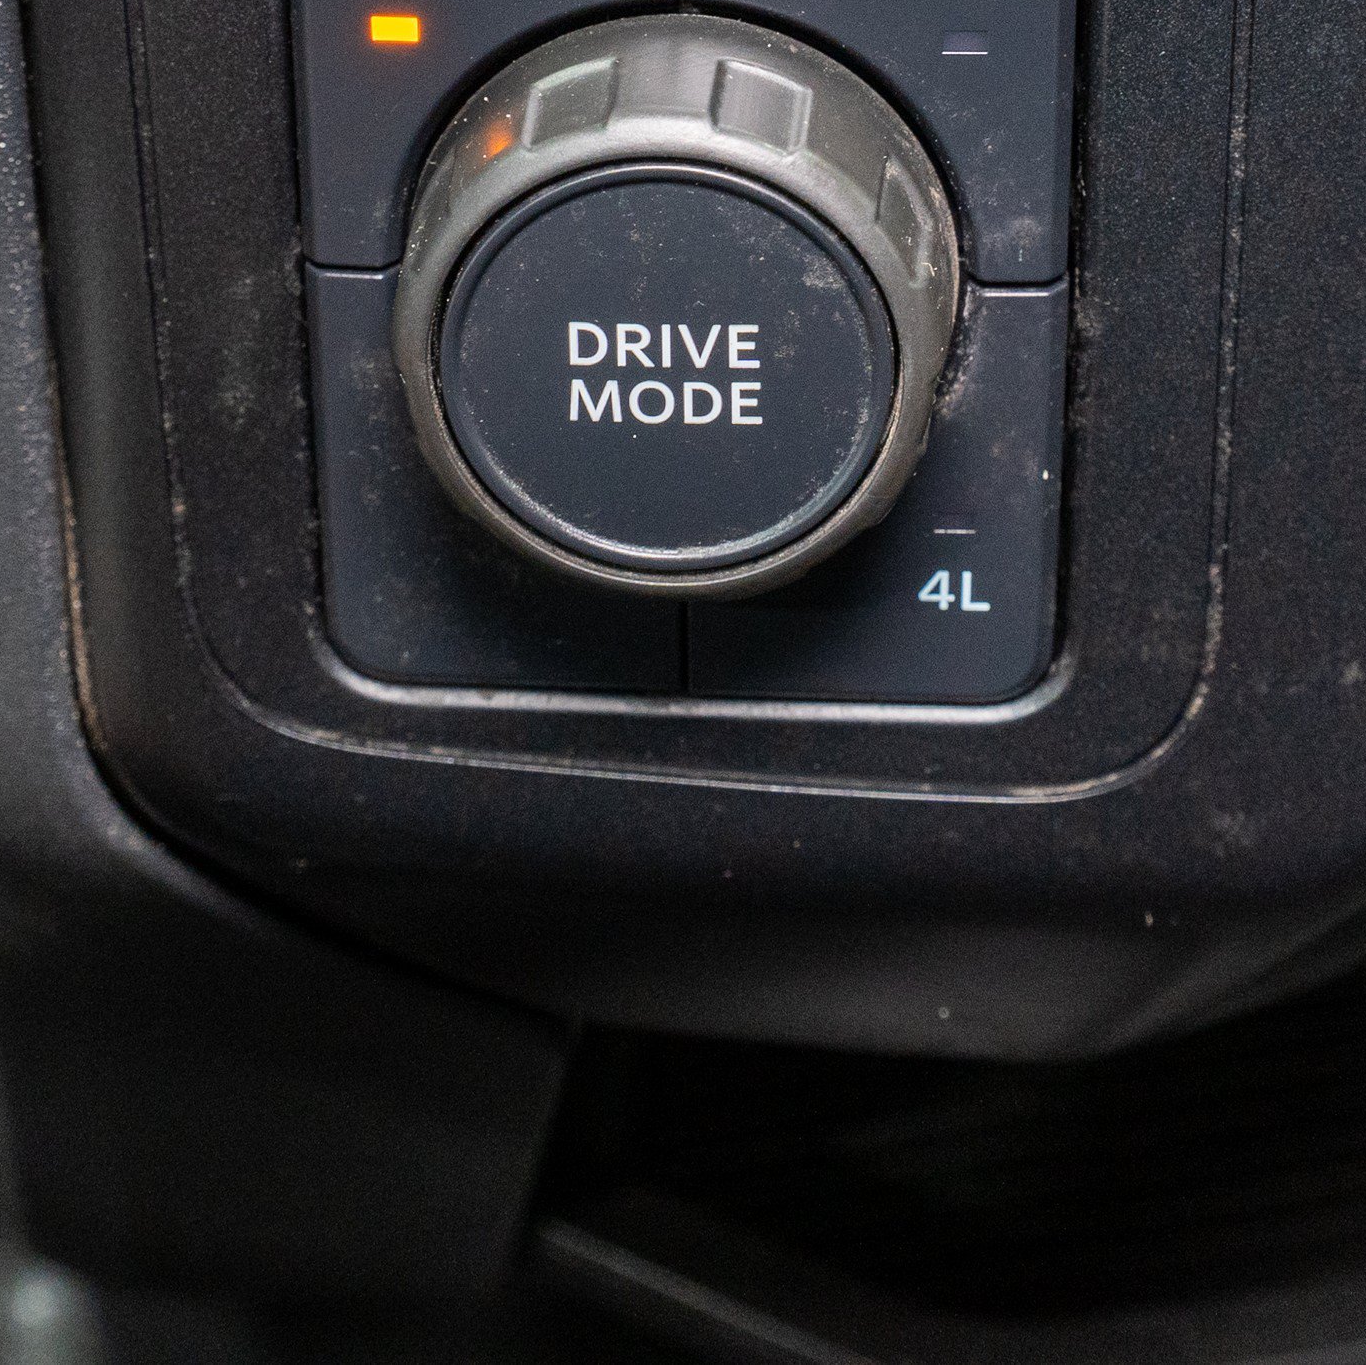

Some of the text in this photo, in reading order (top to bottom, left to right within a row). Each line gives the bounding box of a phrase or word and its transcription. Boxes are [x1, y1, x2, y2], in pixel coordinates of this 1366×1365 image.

[567, 320, 762, 370] DRIVE
[568, 379, 764, 426] MODE
[917, 570, 993, 612] 4L
